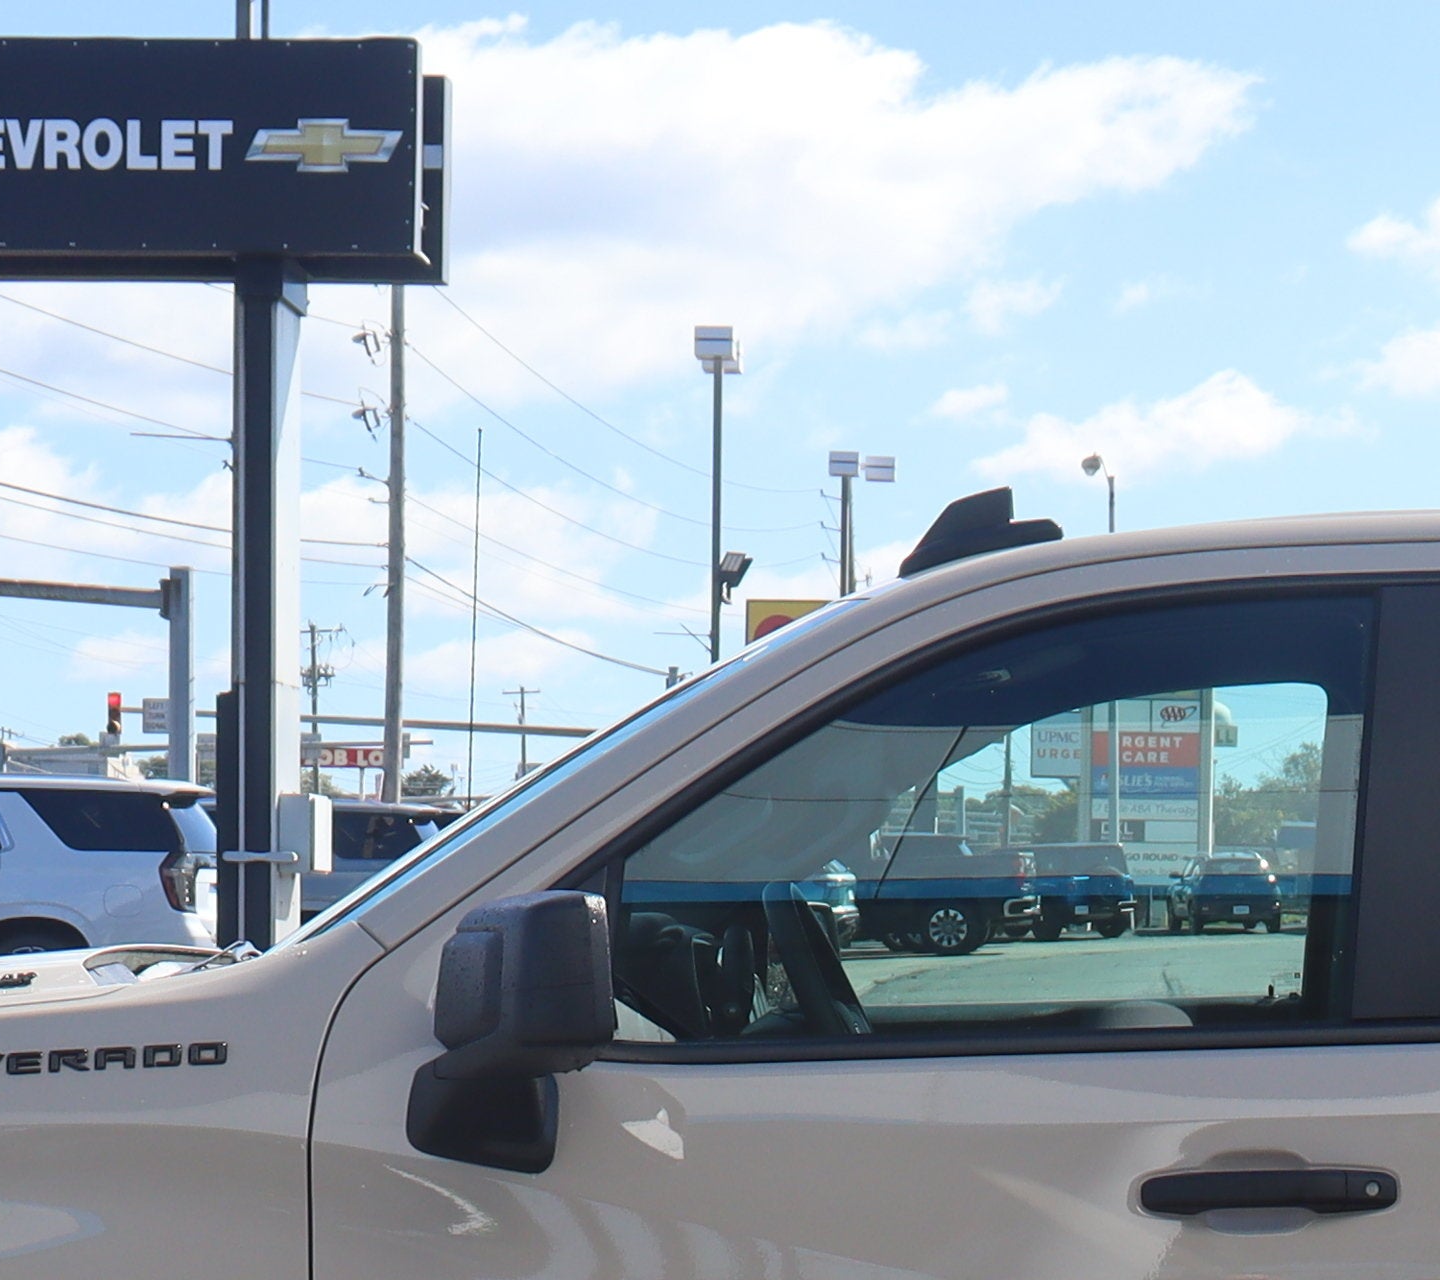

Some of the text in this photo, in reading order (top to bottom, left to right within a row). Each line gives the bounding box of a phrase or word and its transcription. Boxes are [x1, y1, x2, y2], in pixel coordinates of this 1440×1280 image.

[1038, 731, 1079, 743] UPMC
[1122, 735, 1183, 748] RGENT
[356, 749, 385, 767] LO
[1122, 751, 1169, 763] CARE
